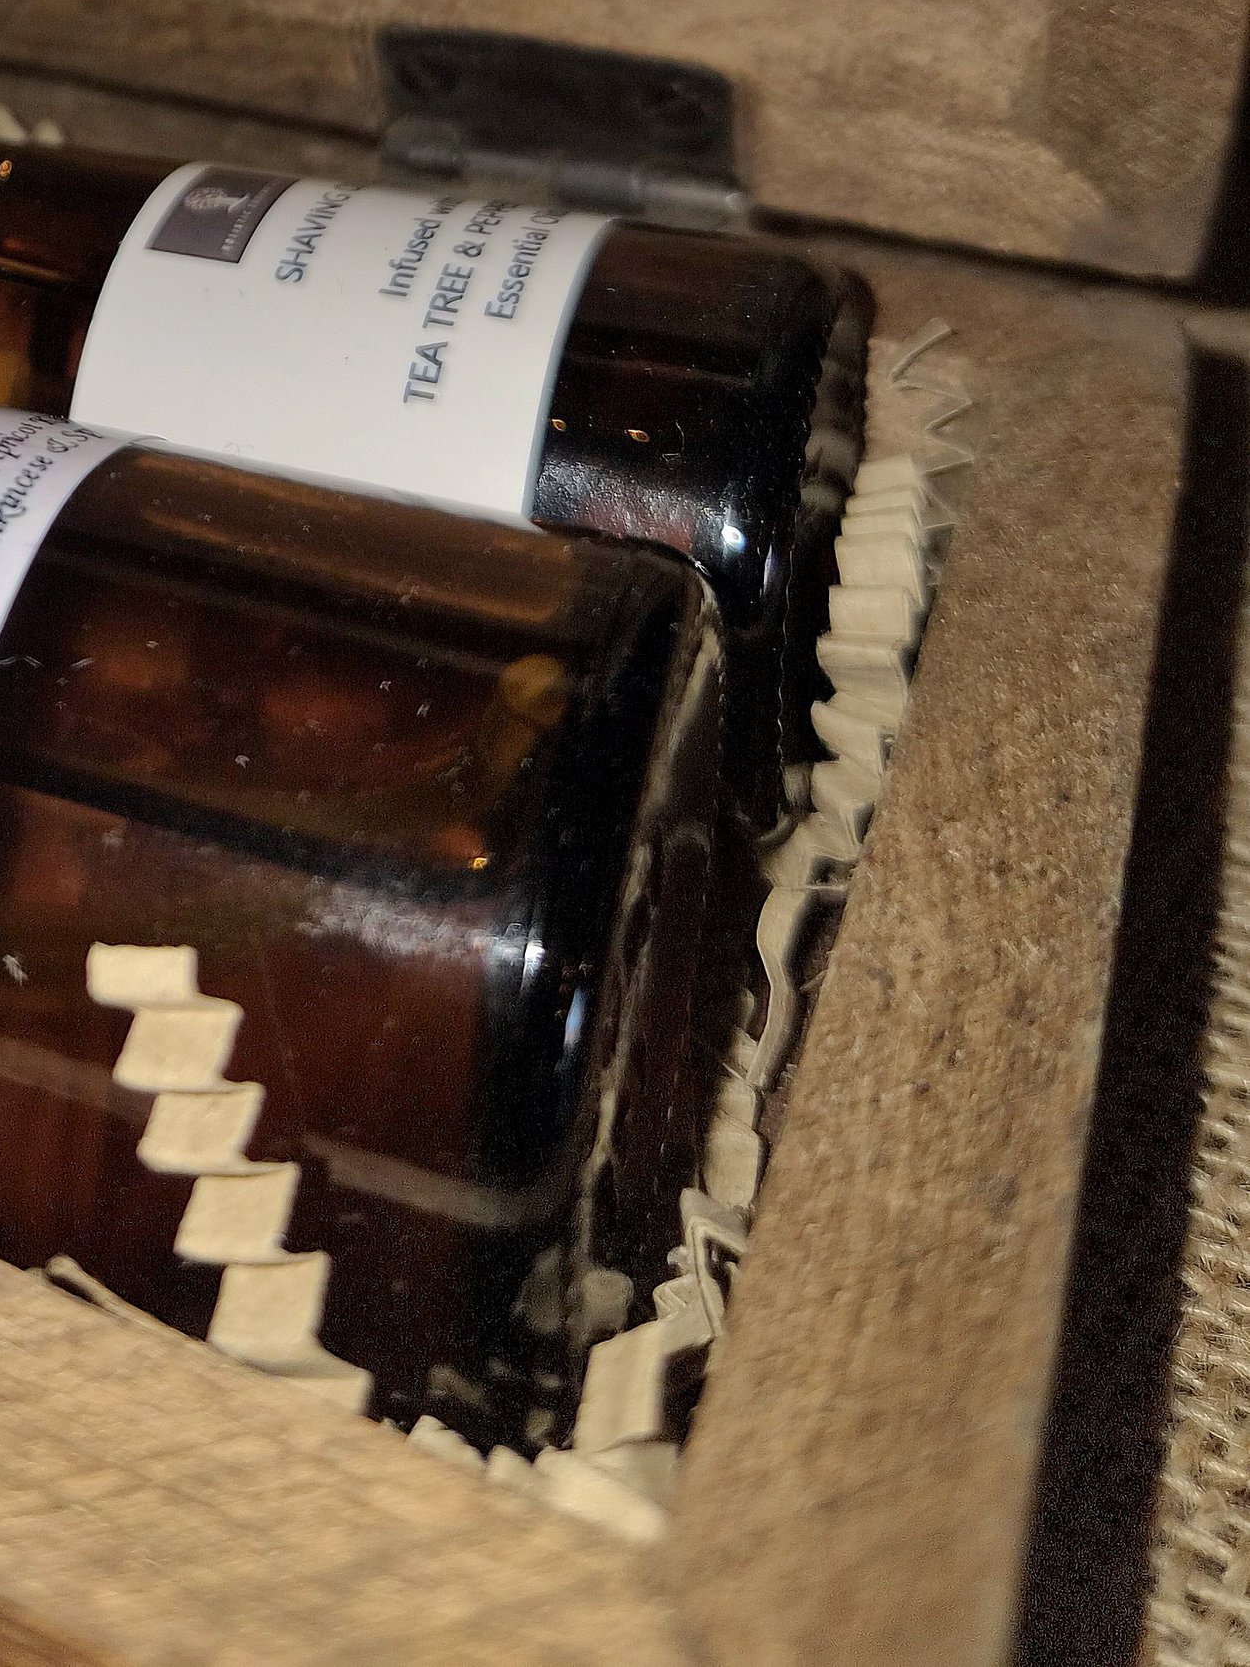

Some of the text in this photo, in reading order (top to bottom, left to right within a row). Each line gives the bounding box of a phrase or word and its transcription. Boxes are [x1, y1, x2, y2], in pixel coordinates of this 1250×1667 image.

[275, 191, 351, 283] SHAVING
[378, 216, 442, 297] Infused
[452, 240, 486, 258] &
[483, 226, 551, 319] Essential
[422, 263, 474, 328] TREE
[402, 341, 449, 403] TEA
